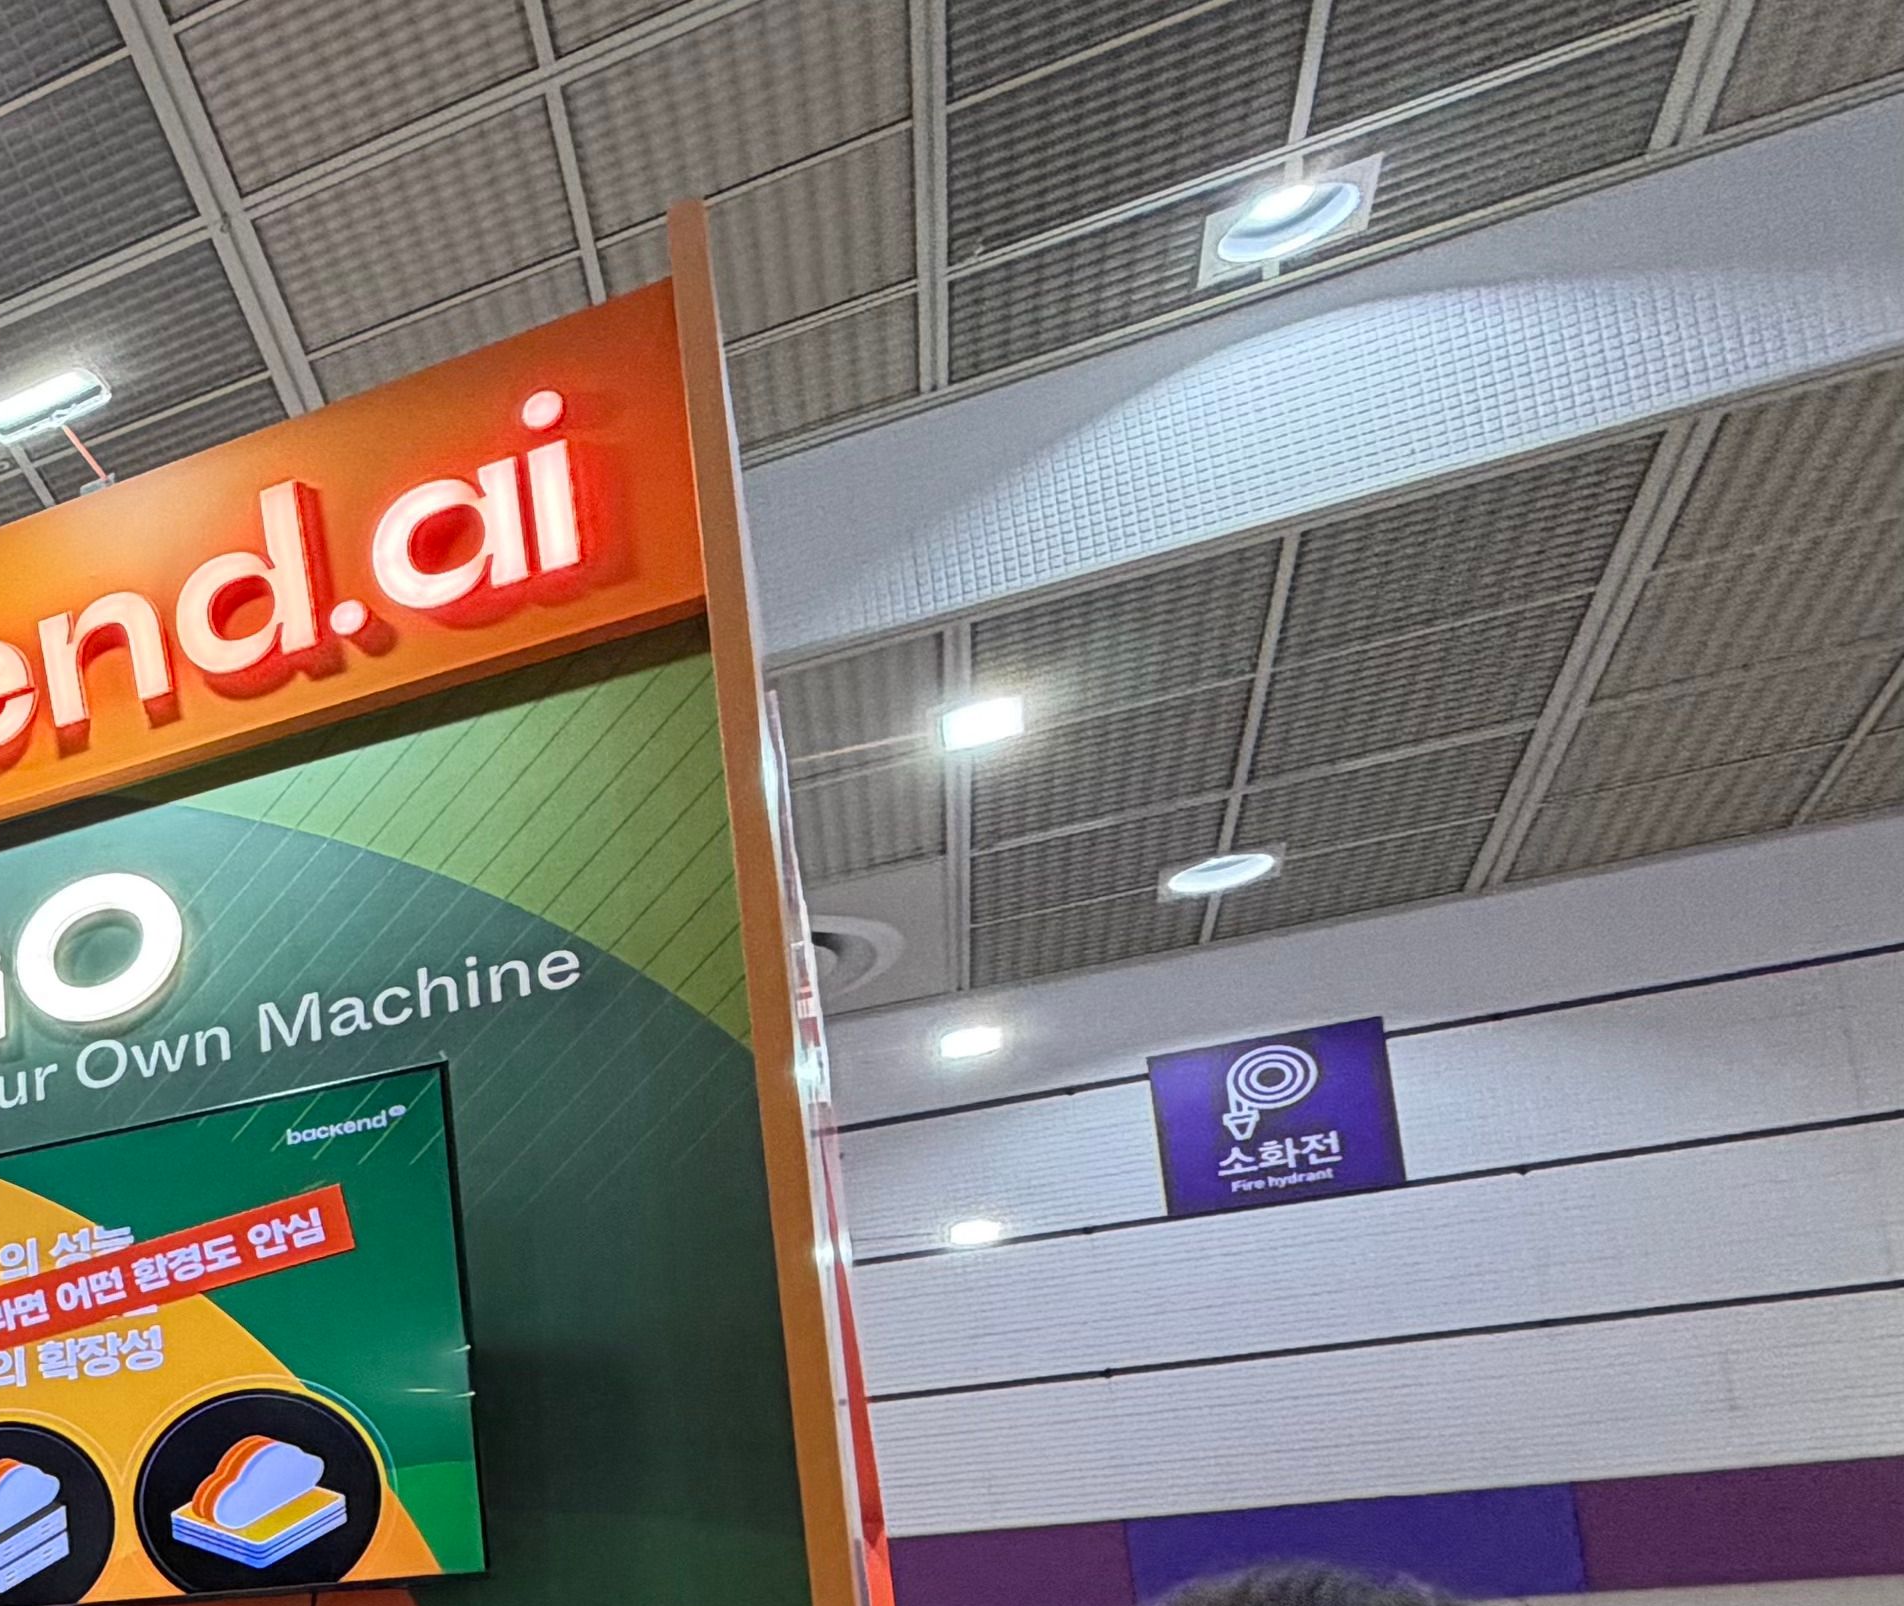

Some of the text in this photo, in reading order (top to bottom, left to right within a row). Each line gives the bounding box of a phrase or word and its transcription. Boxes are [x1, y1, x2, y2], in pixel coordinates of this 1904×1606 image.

[75, 1022, 232, 1091] Own
[259, 948, 581, 1056] Machine
[286, 1110, 388, 1145] backend
[1218, 1130, 1343, 1177] 소화전
[1231, 1167, 1334, 1193] Fire hydrant
[56, 1267, 127, 1312] 어떤
[131, 1234, 242, 1294] 환경도
[246, 1206, 326, 1260] 안심
[37, 1324, 164, 1381] 확장성
